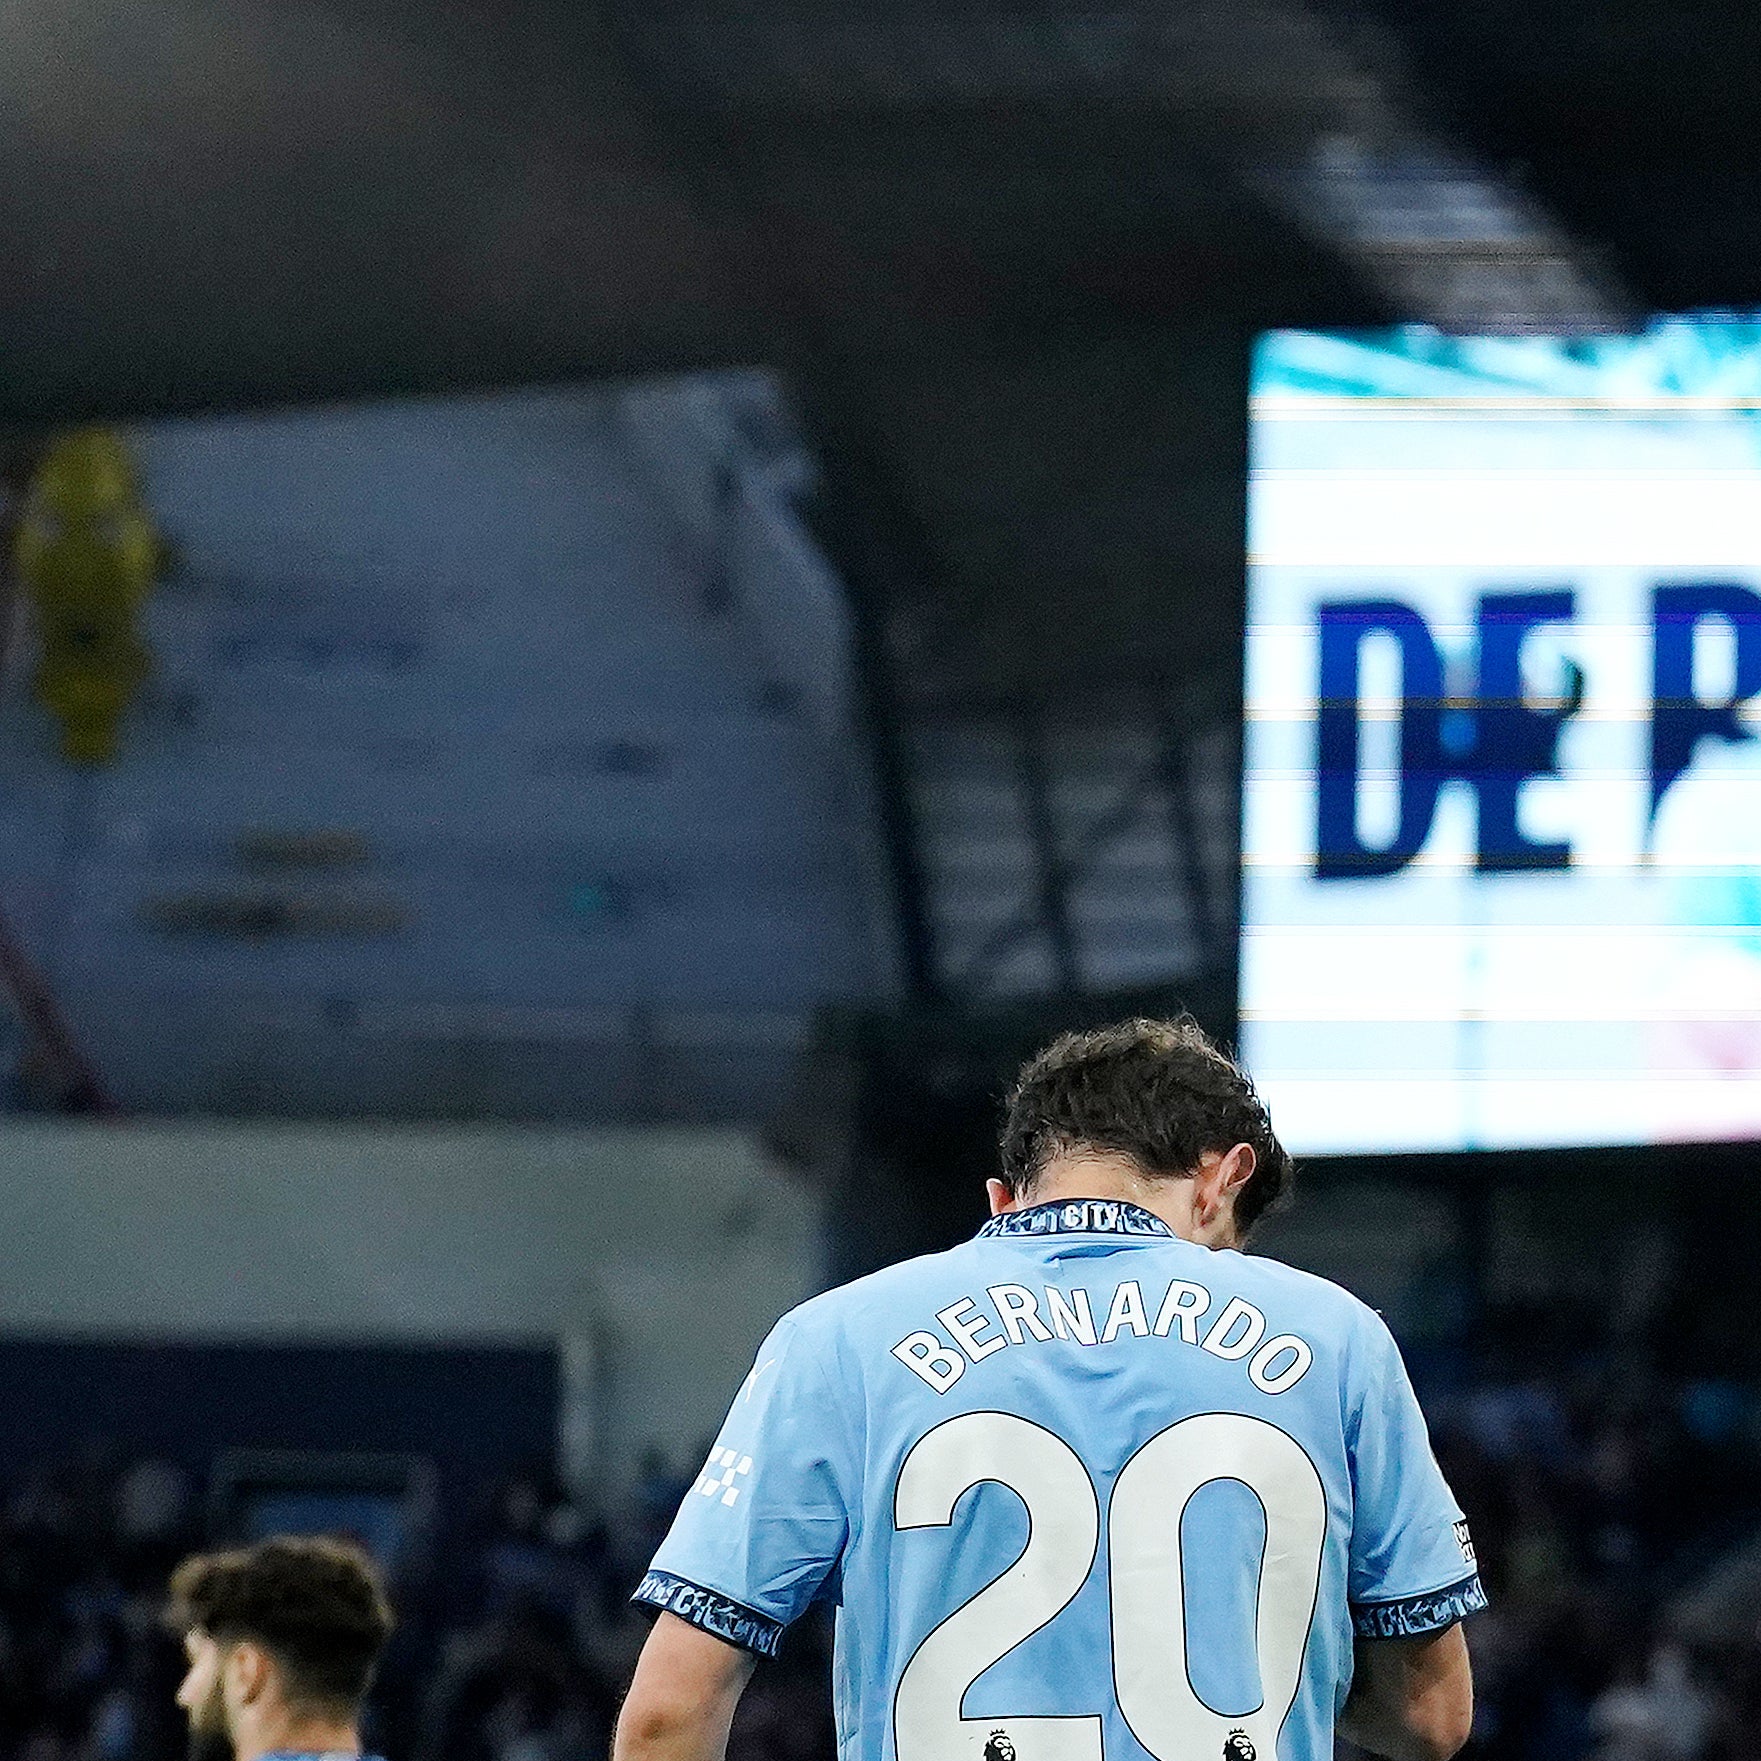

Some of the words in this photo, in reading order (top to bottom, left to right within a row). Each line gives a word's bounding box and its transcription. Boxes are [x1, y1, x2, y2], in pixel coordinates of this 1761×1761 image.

[1315, 590, 1576, 875] DE
[1065, 1201, 1119, 1229] CITY
[891, 1278, 1314, 1396] BERNARDO
